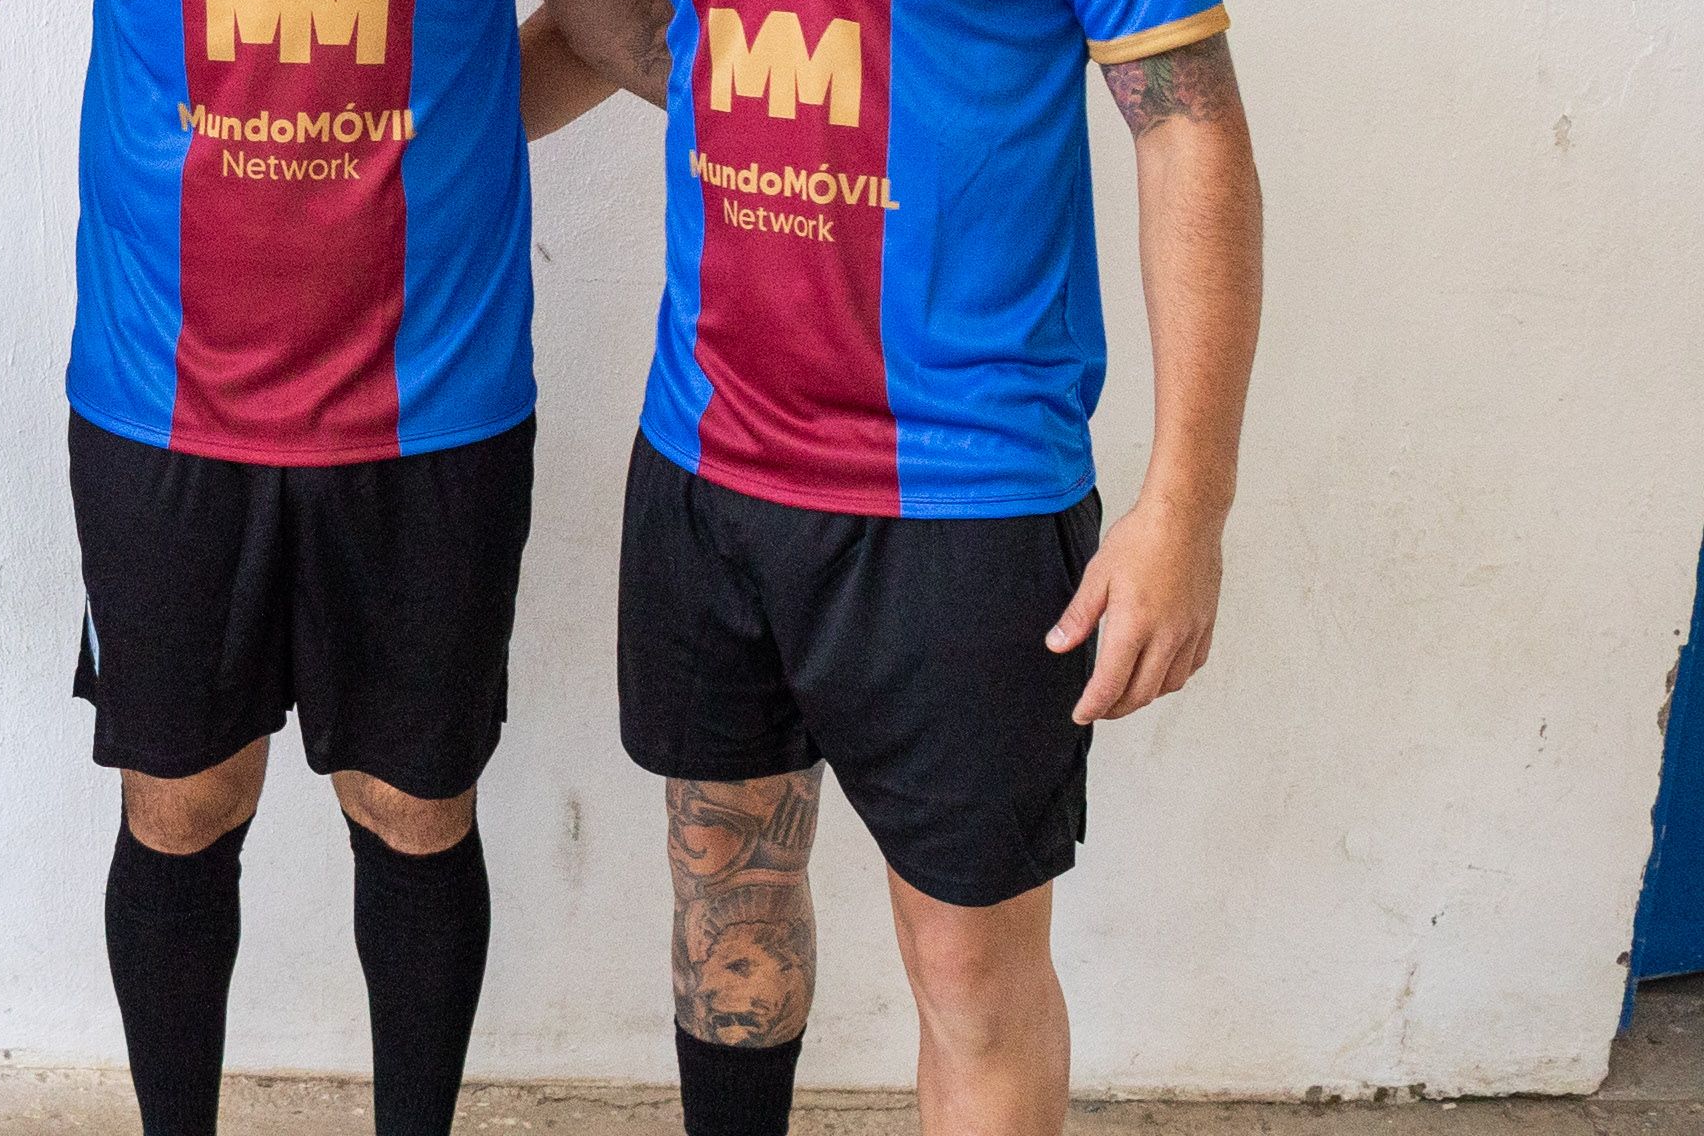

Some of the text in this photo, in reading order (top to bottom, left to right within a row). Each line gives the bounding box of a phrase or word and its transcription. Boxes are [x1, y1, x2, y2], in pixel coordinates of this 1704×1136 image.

[708, 7, 862, 128] MM
[222, 148, 360, 181] Network
[689, 149, 900, 210] MundoMÓVIL
[723, 197, 835, 242] Network
